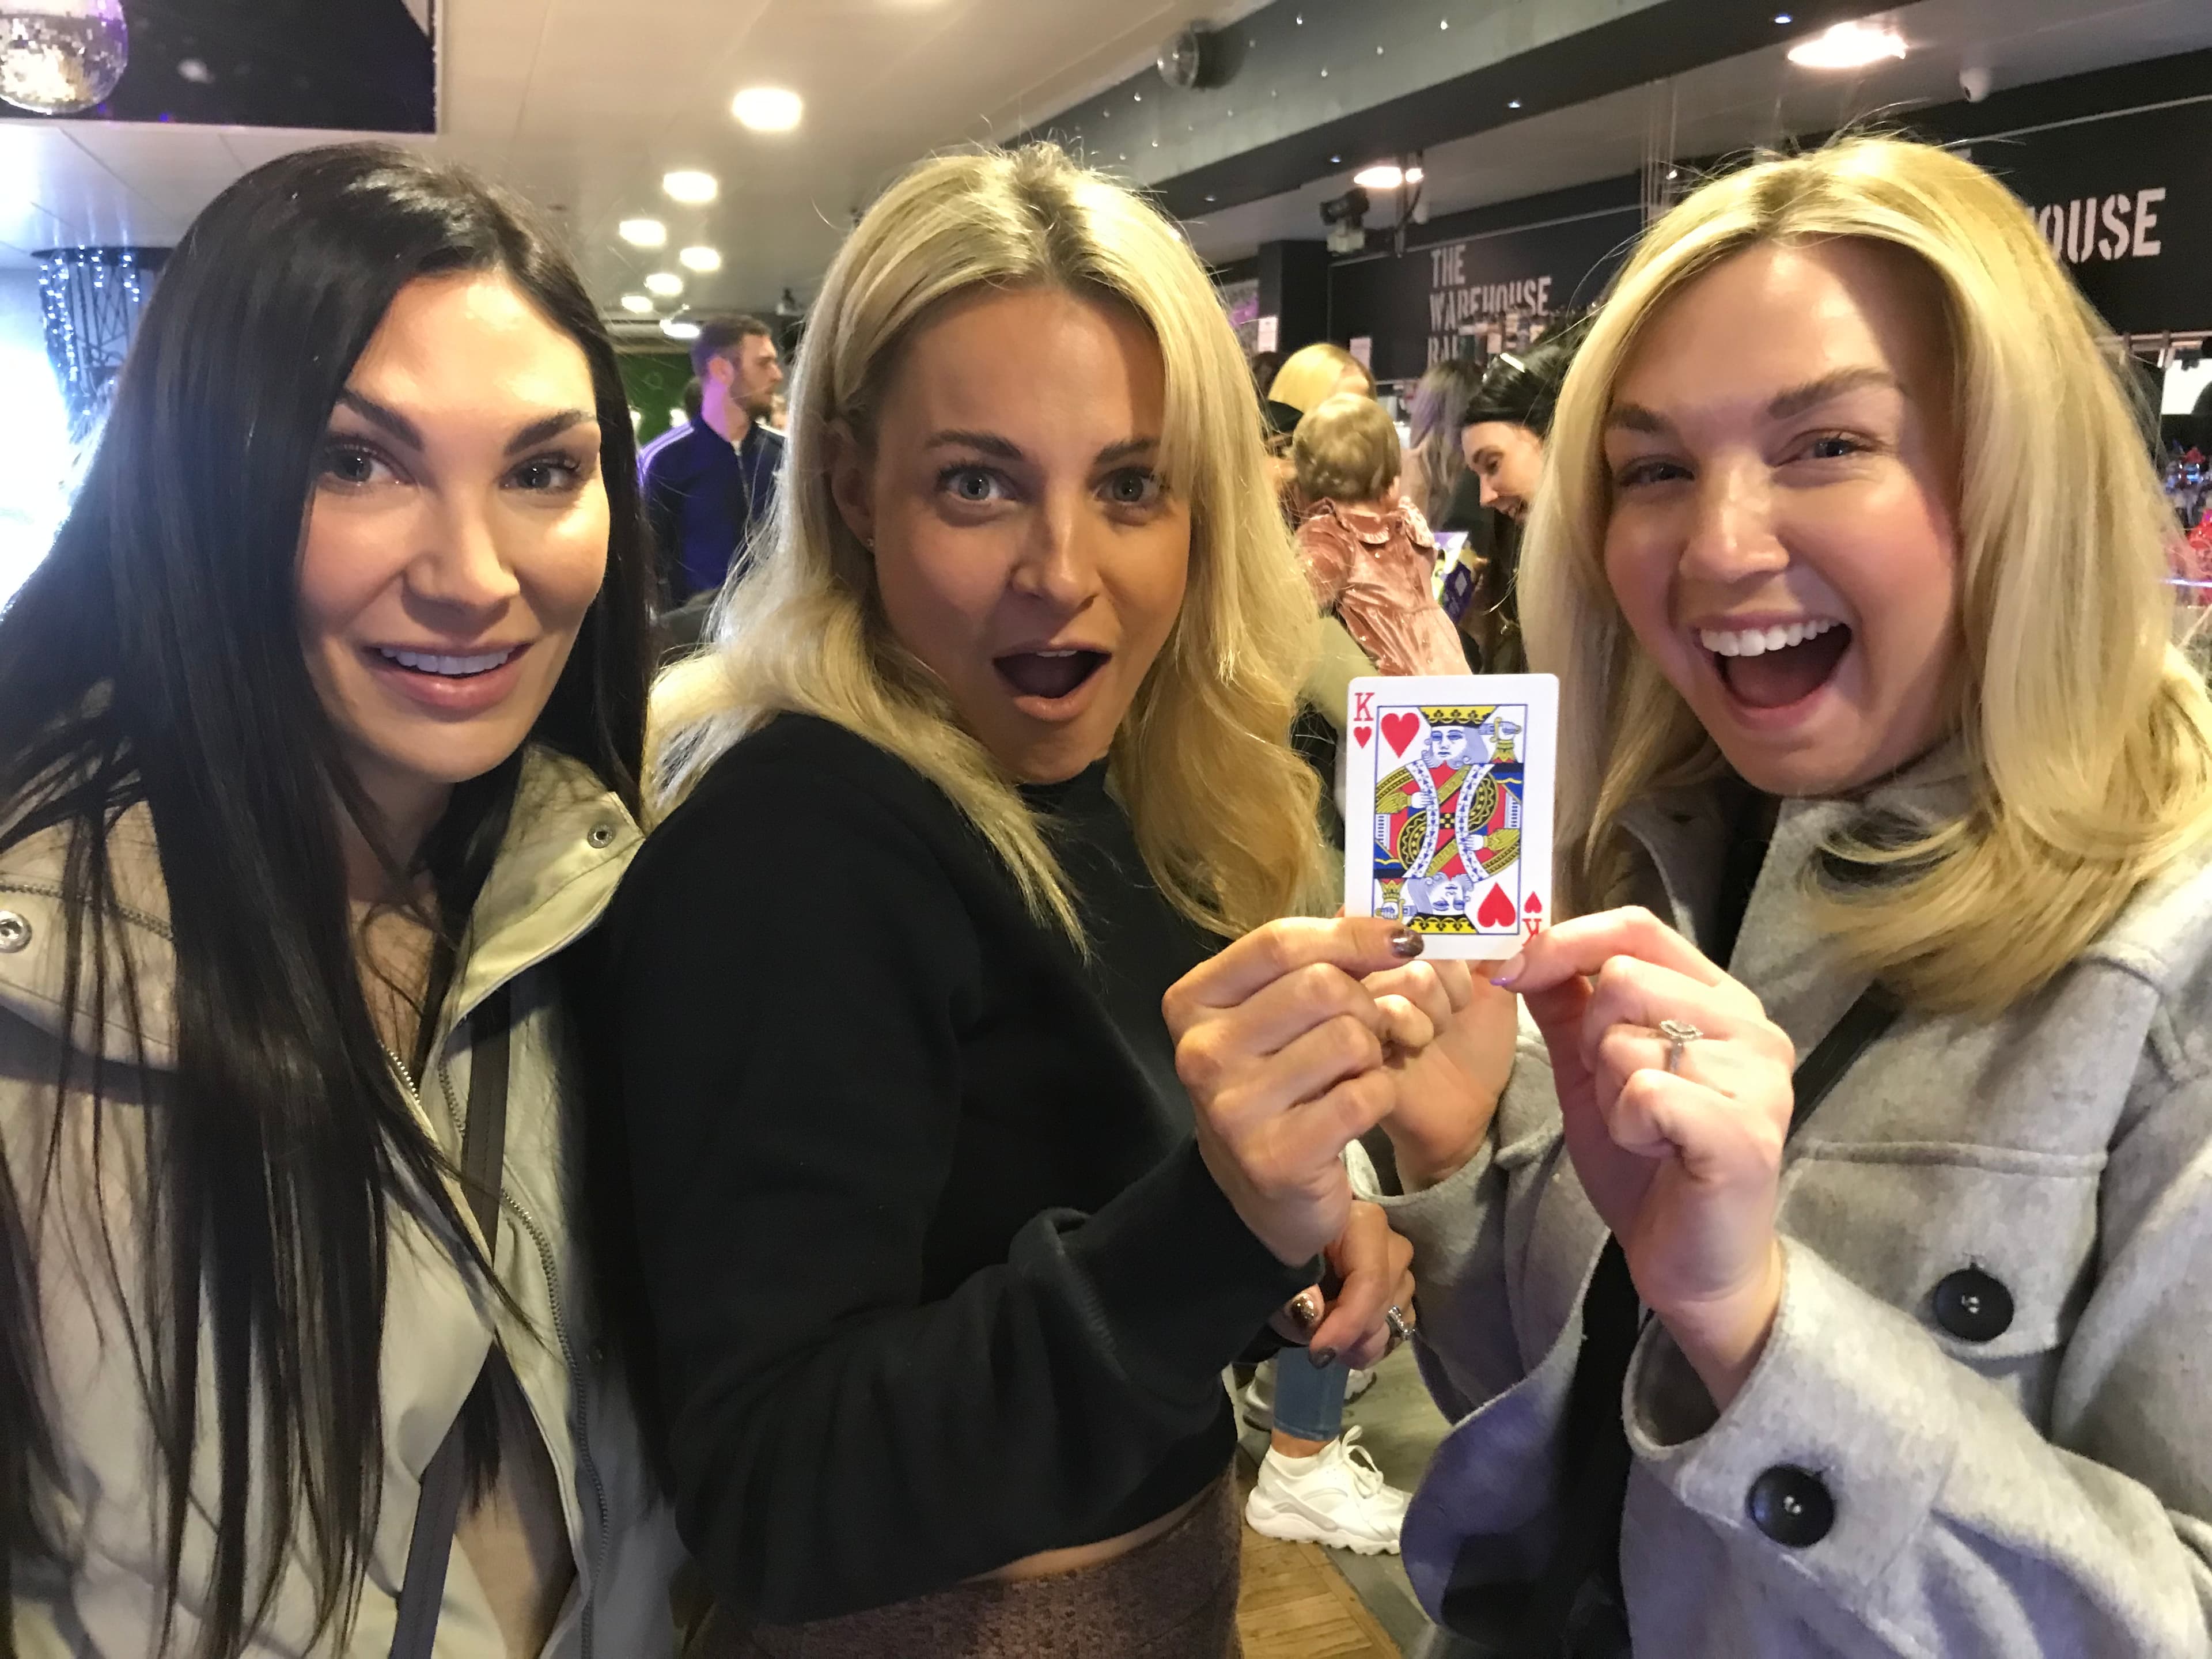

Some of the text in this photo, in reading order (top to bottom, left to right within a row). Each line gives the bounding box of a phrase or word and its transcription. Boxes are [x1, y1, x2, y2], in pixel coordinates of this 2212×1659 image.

[2025, 187, 2166, 264] OUSE
[1430, 244, 1466, 288] THE
[1429, 275, 1552, 332] WAREHOUSE
[1354, 692, 1375, 722] K
